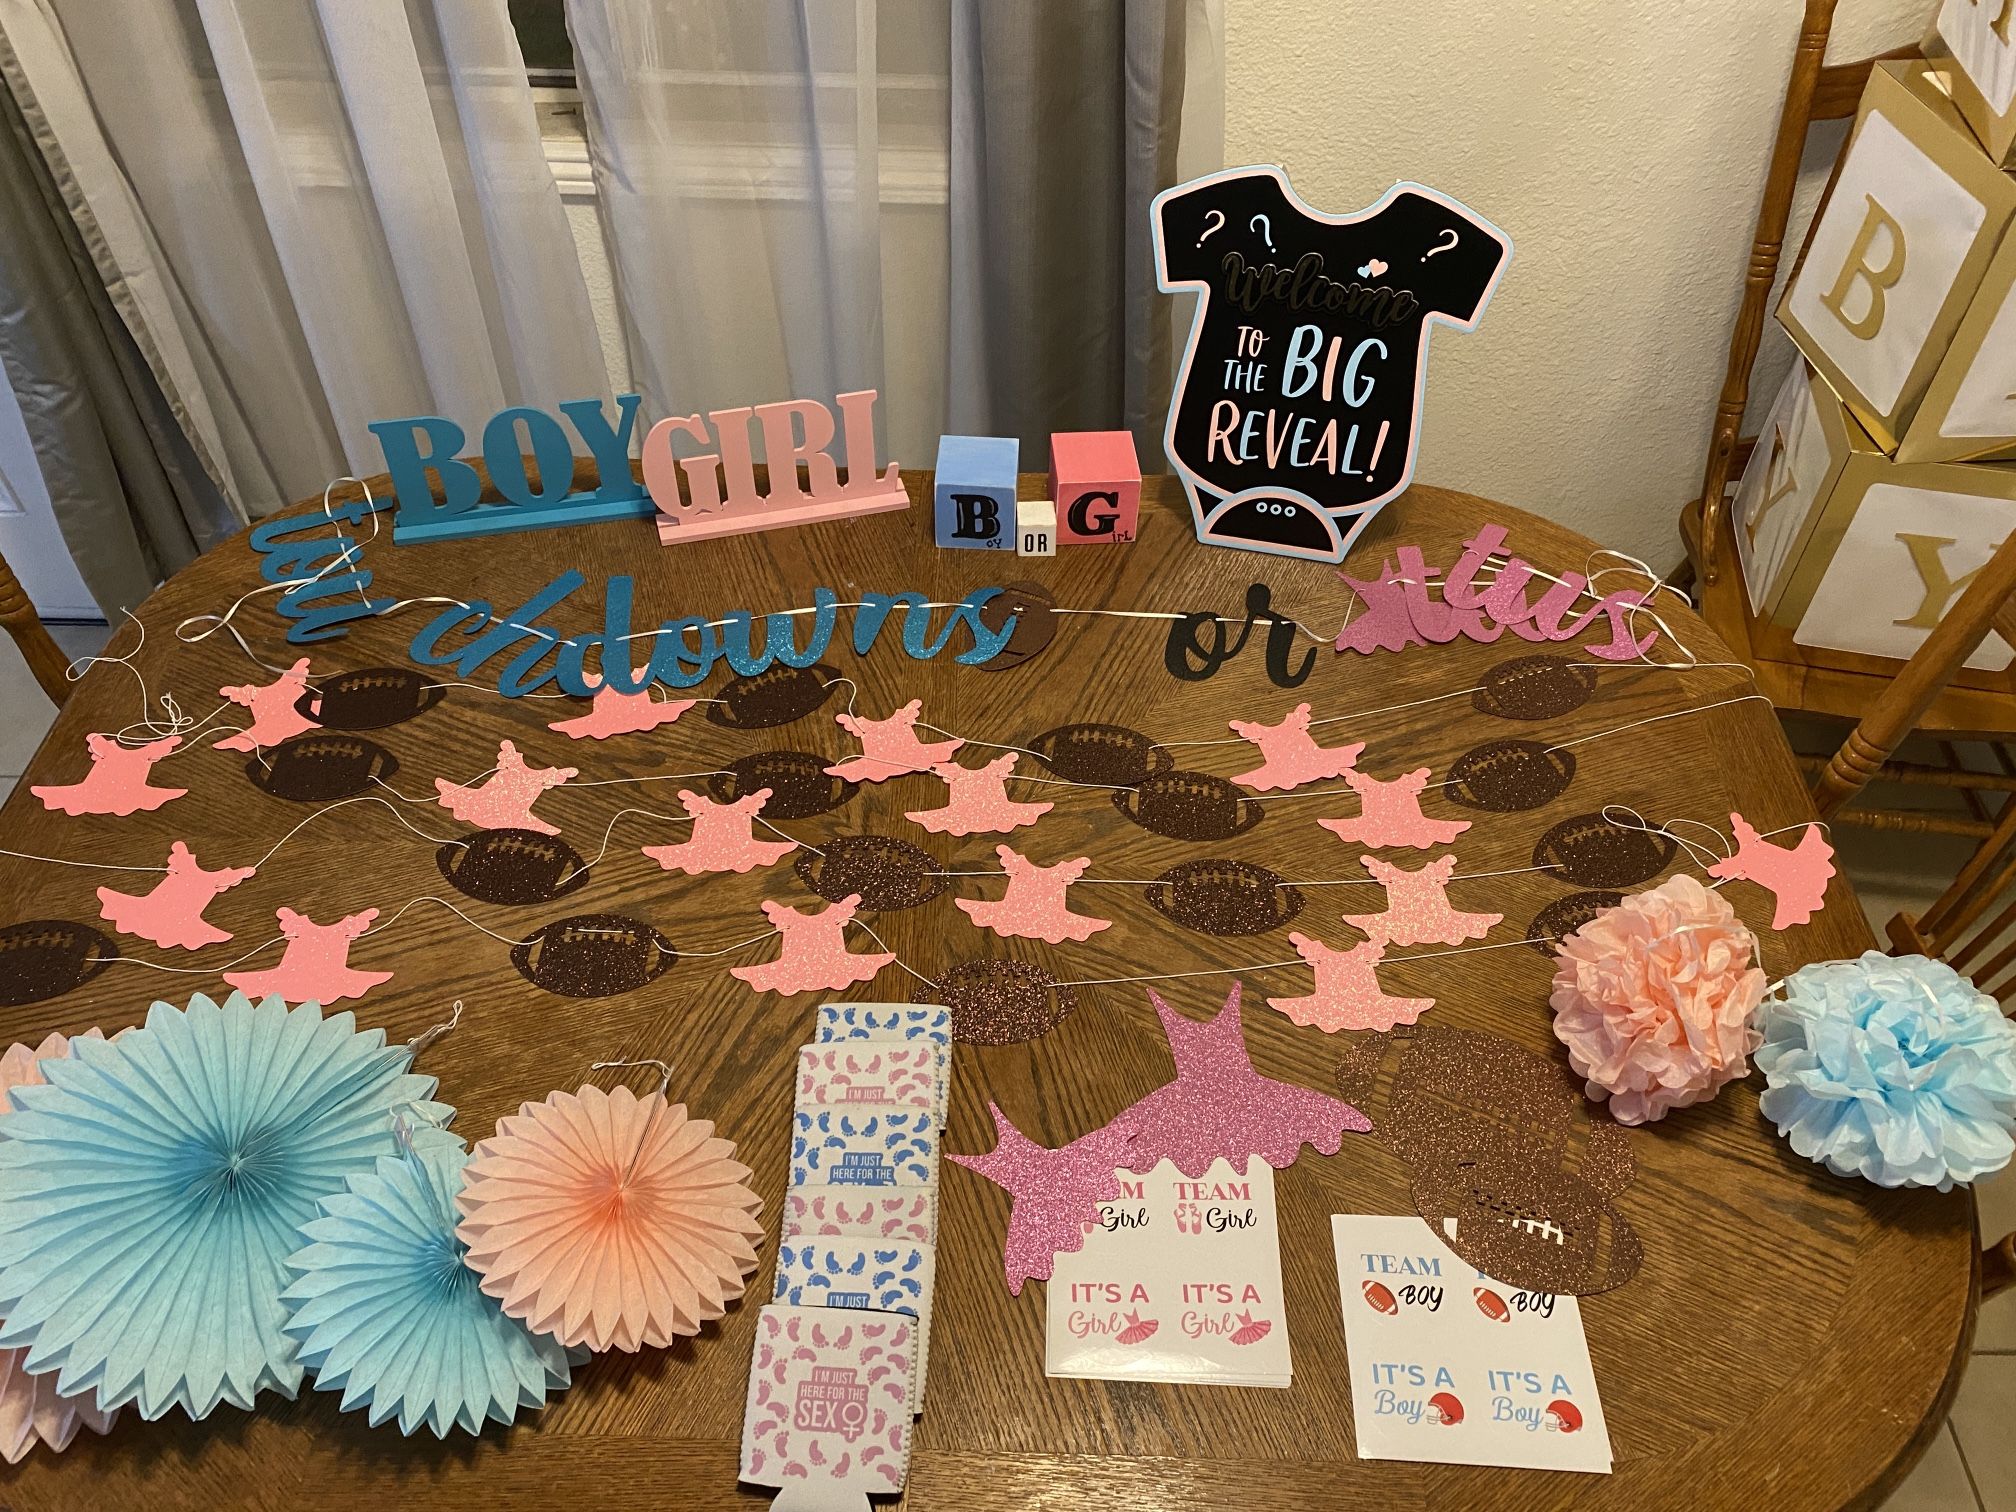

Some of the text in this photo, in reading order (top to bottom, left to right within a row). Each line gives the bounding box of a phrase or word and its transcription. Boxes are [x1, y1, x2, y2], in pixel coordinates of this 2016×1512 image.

[1819, 193, 1907, 340] B
[1237, 326, 1270, 357] TO
[1223, 360, 1267, 393] THE
[1281, 324, 1388, 408] BIG
[1207, 400, 1391, 482] REVEAL!
[368, 394, 645, 525] BOY
[642, 390, 898, 518] GIRL
[1024, 533, 1048, 553] OR
[1165, 583, 1318, 688] or
[848, 1089, 882, 1100] I'M JUST
[845, 1154, 880, 1166] I'M JUST
[832, 1168, 892, 1180] HERE FOR THE
[1173, 1182, 1252, 1200] TEAM
[1098, 1206, 1150, 1232] Girl
[1206, 1207, 1257, 1232] Girl
[1361, 1253, 1442, 1277] TEAM
[829, 1295, 868, 1308] I'M JUST
[1071, 1283, 1149, 1303] IT'S A
[1182, 1284, 1261, 1304] IT'S A
[1068, 1310, 1121, 1339] Girl
[1181, 1311, 1234, 1339] Girl
[815, 1370, 854, 1385] I'M JUST
[1372, 1363, 1455, 1388] IT'S A
[1488, 1370, 1573, 1395] IT'S A
[800, 1385, 865, 1401] HERE FOR THE
[798, 1399, 838, 1428] SEX
[1374, 1390, 1427, 1425] Boy
[1491, 1396, 1544, 1432] Boy
